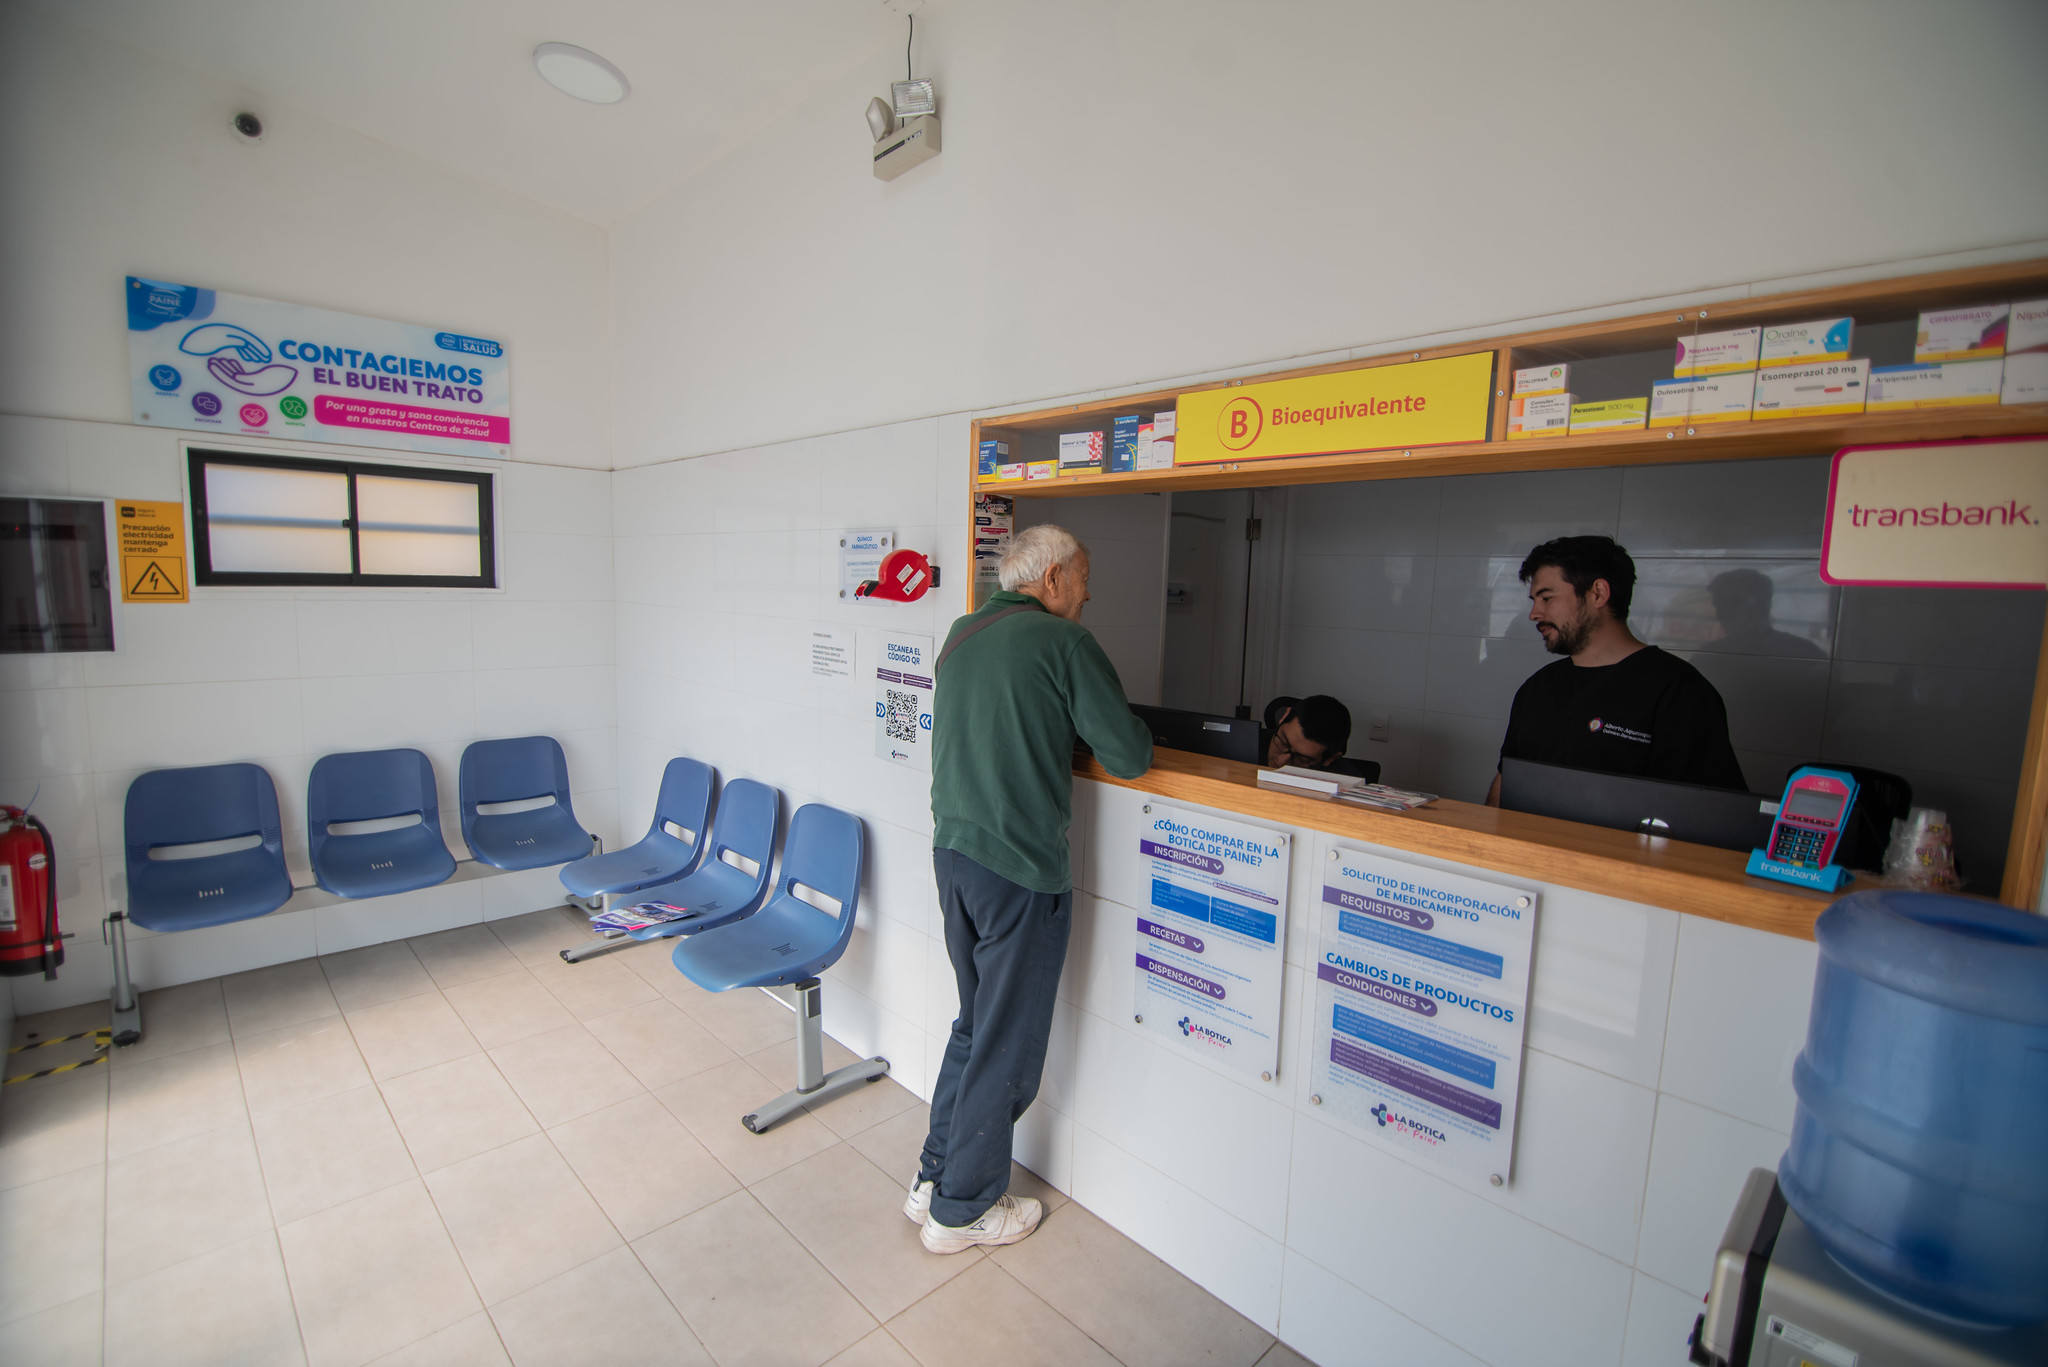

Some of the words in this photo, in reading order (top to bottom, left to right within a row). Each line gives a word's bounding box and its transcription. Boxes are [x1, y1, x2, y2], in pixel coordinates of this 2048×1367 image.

[149, 295, 181, 307] PAINE
[1929, 311, 1992, 324] CIPROFIBRATO
[463, 343, 498, 356] SALUD
[278, 339, 483, 386] CONTAGIEMOS
[1761, 369, 1824, 381] Esomeprazol
[1827, 366, 1839, 375] 20
[1841, 366, 1857, 374] mg
[313, 367, 341, 386] EL
[346, 371, 408, 394] BUEN
[412, 381, 483, 404] TRATO
[1518, 377, 1548, 385] CITALOPRAM
[1875, 374, 1917, 384] Aripiprazol
[1657, 387, 1695, 396] Duloxetina
[326, 401, 345, 411] Por
[346, 404, 367, 412] una
[368, 406, 398, 418] grata
[399, 409, 406, 419] y
[407, 411, 432, 420] sana
[433, 414, 489, 427] convivencia
[1271, 395, 1426, 426] Bioequivalente
[1573, 405, 1606, 414] Paracetamol
[1608, 403, 1622, 411] 500
[347, 414, 360, 423] en
[361, 416, 408, 428] nuestros
[409, 420, 448, 432] Centros
[449, 423, 461, 434] de
[463, 425, 490, 437] Salud
[1230, 410, 1248, 438] B
[122, 524, 171, 532] Precaución
[123, 531, 174, 540] electricidad
[123, 539, 168, 547] mantenga
[887, 643, 914, 655] ESCANEA
[914, 647, 921, 656] EL
[887, 652, 911, 663] CÓDIGO
[911, 656, 921, 665] QR
[1153, 819, 1189, 836] ¿CÓMO
[1191, 828, 1243, 849] COMPRAR
[1246, 842, 1262, 855] EN
[1264, 845, 1279, 859] LA
[1168, 834, 1205, 851] BOTICA
[1207, 844, 1222, 857] DE
[1224, 848, 1263, 867] PAINE?
[1154, 845, 1209, 868] INSCRIPCIÓN
[1342, 866, 1398, 889] SOLICITUD
[1400, 881, 1416, 894] DE
[1418, 886, 1521, 921] INCORPORACIÓN
[1376, 887, 1391, 900] DE
[1392, 891, 1480, 923] MEDICAMENTO
[1340, 893, 1411, 921] REQUISITOS
[1150, 924, 1186, 945] RECETAS
[1149, 961, 1210, 993] DISPENSACIÓN
[1326, 952, 1389, 982] CAMBIOS
[1391, 973, 1411, 989] DE
[1414, 980, 1514, 1022] PRODUCTOS
[1336, 973, 1417, 1009] CONDICIONES
[1195, 1024, 1204, 1034] LA
[1205, 1026, 1232, 1046] BOTICA
[1196, 1032, 1205, 1041] De
[1208, 1037, 1226, 1049] Paine
[1394, 1112, 1407, 1125] LA
[1408, 1117, 1446, 1142] BOTICA
[1396, 1122, 1408, 1133] De
[1413, 1130, 1437, 1147] Paine
